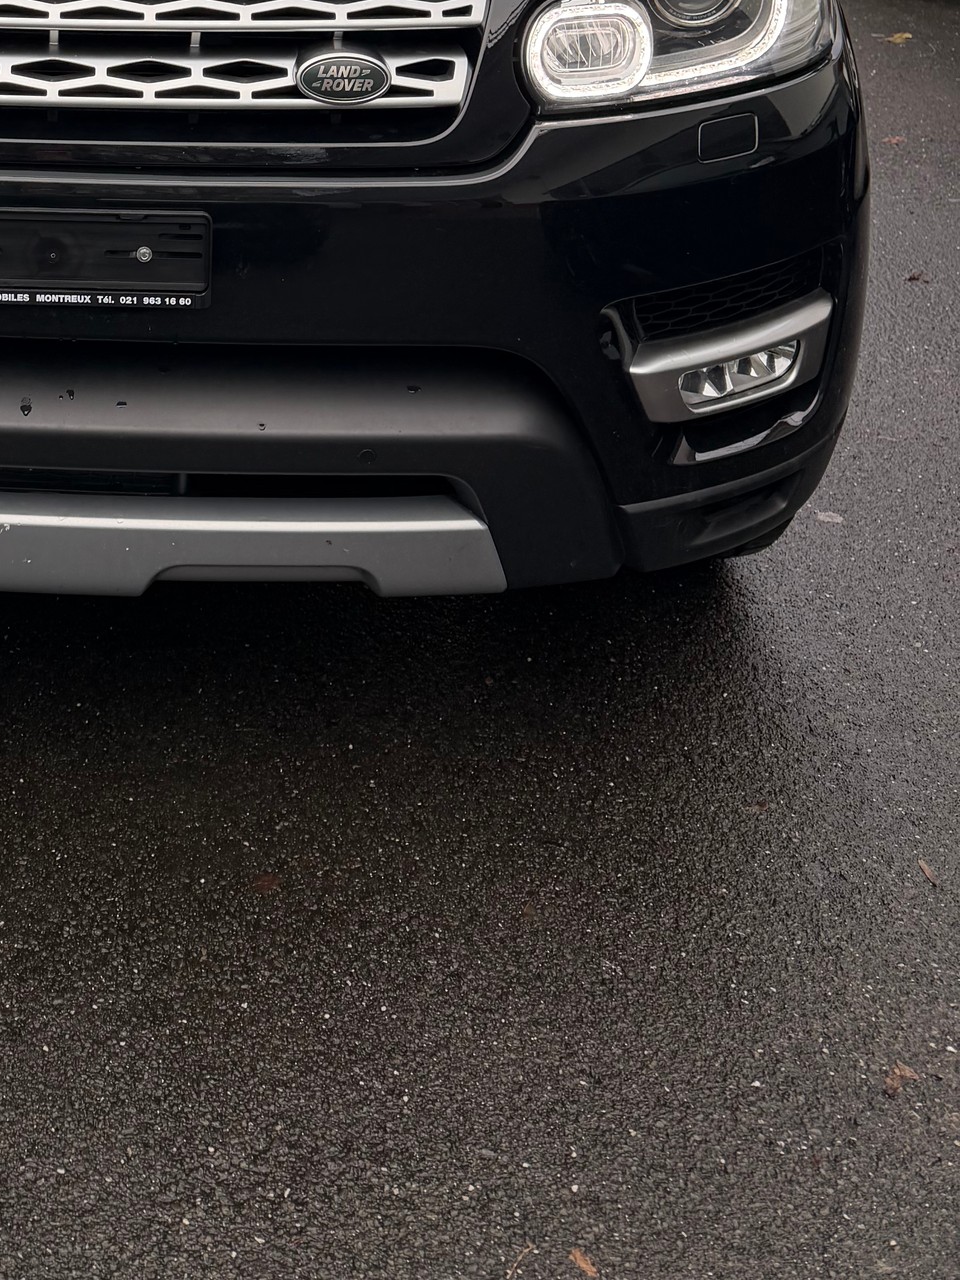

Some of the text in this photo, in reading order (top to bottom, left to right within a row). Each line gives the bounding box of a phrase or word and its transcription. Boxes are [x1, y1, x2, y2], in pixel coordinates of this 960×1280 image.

[317, 65, 374, 91] LAND ROVER
[36, 293, 91, 303] MONTREUX
[97, 294, 114, 304] Tél.
[119, 295, 137, 305] 021
[143, 296, 161, 305] 963
[165, 296, 176, 306] 16
[179, 297, 192, 306] 60
